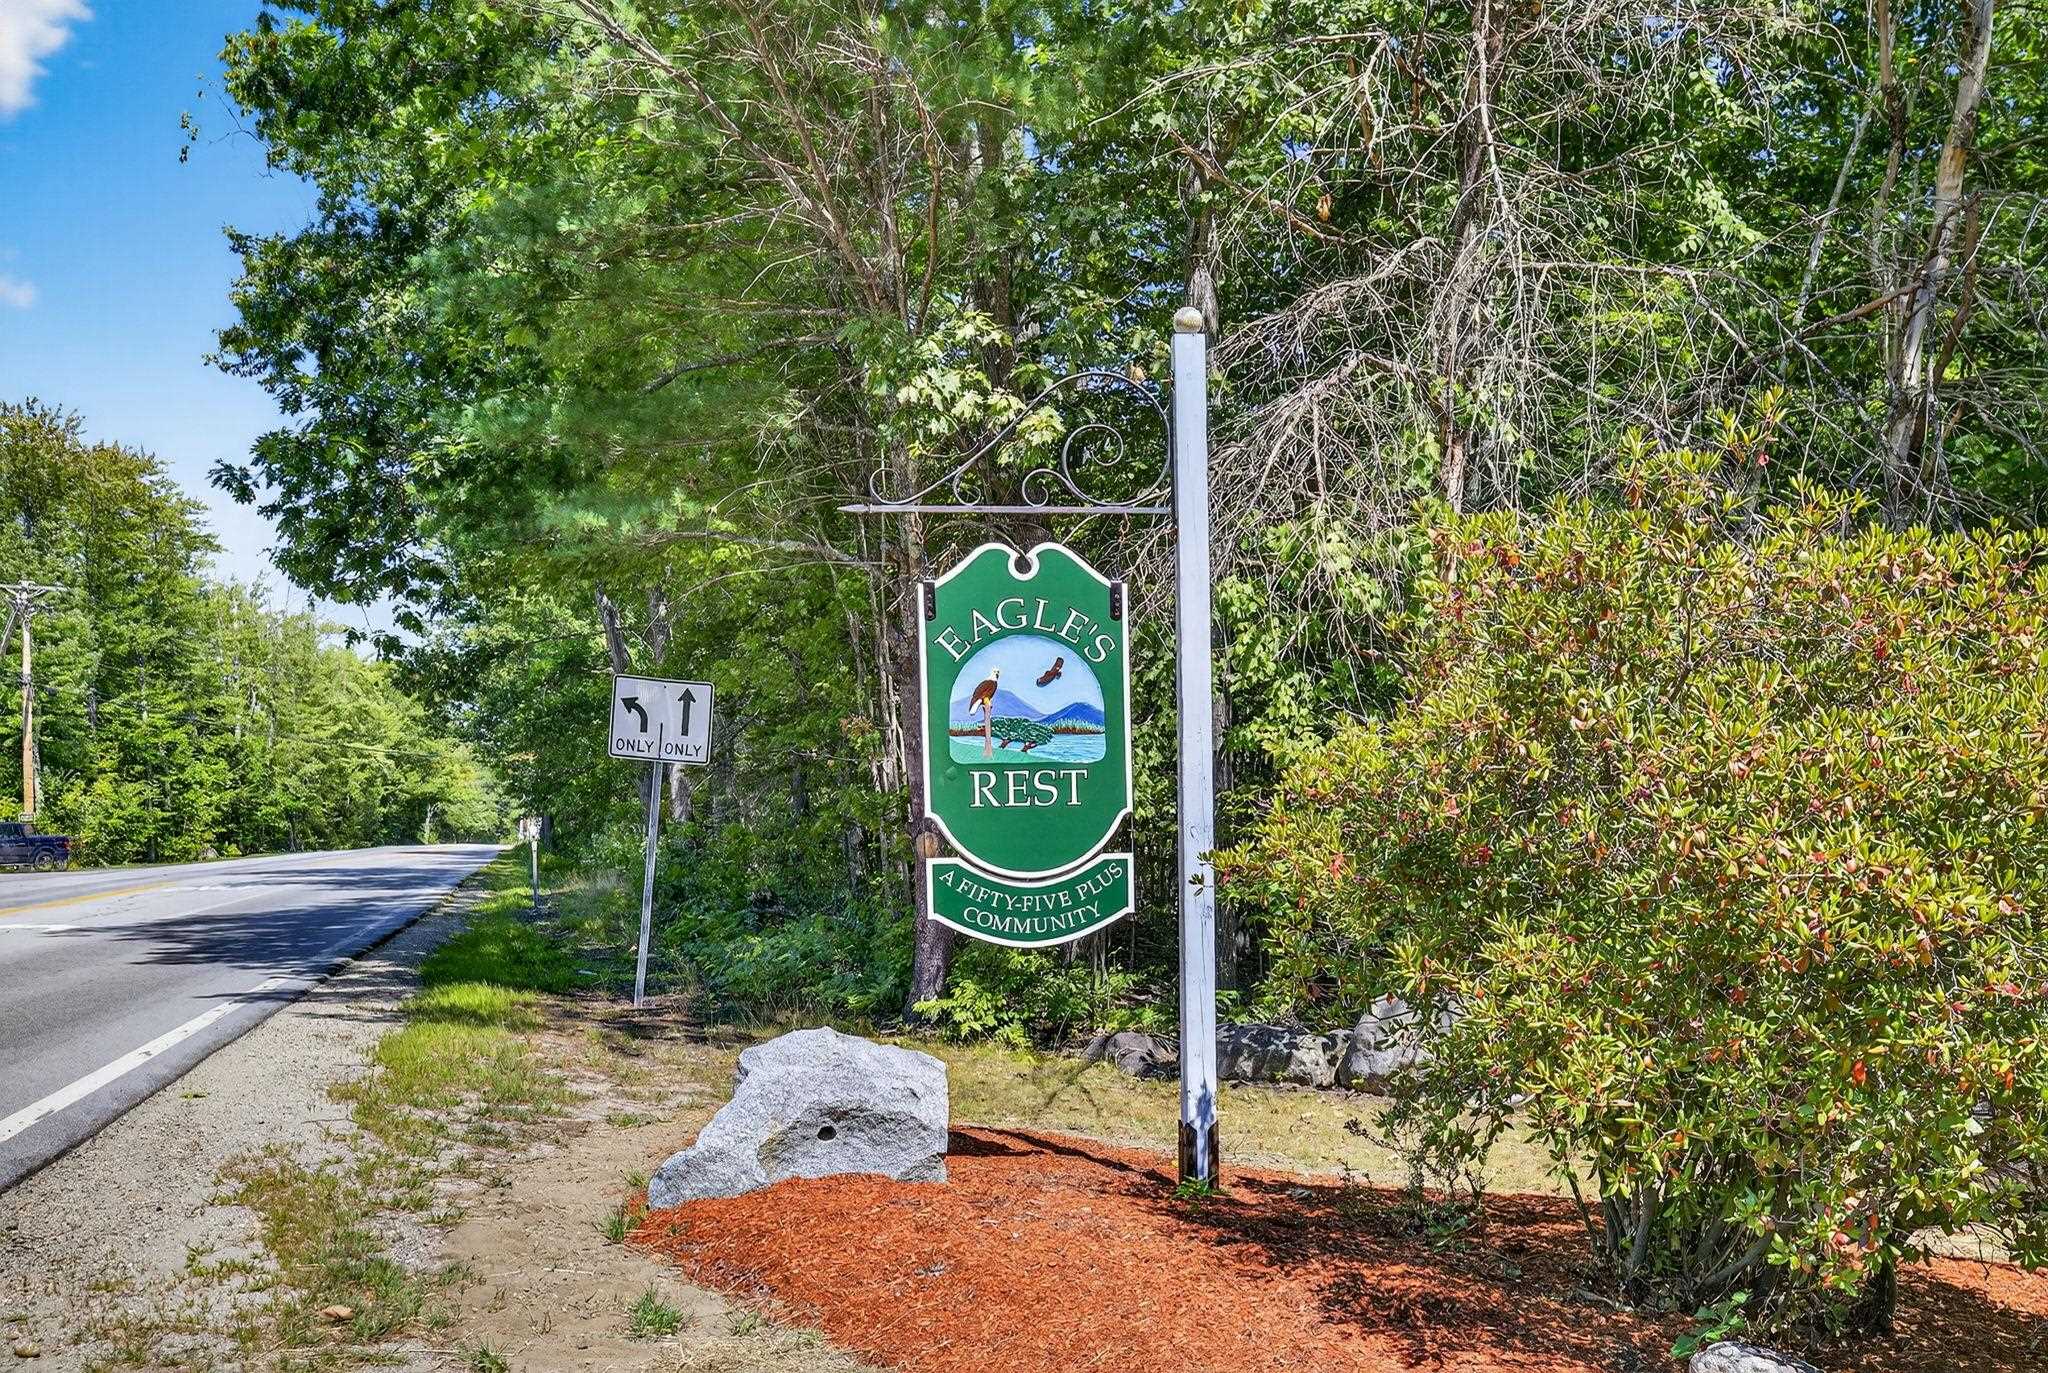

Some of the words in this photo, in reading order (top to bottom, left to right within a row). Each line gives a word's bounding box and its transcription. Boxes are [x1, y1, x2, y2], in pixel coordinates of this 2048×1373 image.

[934, 597, 1116, 663] EAGLE'S
[616, 738, 654, 753] ONLY
[664, 742, 702, 757] ONLY
[969, 769, 1088, 807] REST
[939, 870, 953, 887] A
[956, 877, 1072, 912] FIFTY-FIVE
[1075, 862, 1123, 900] PLUS
[963, 901, 1100, 934] COMMUNITY
